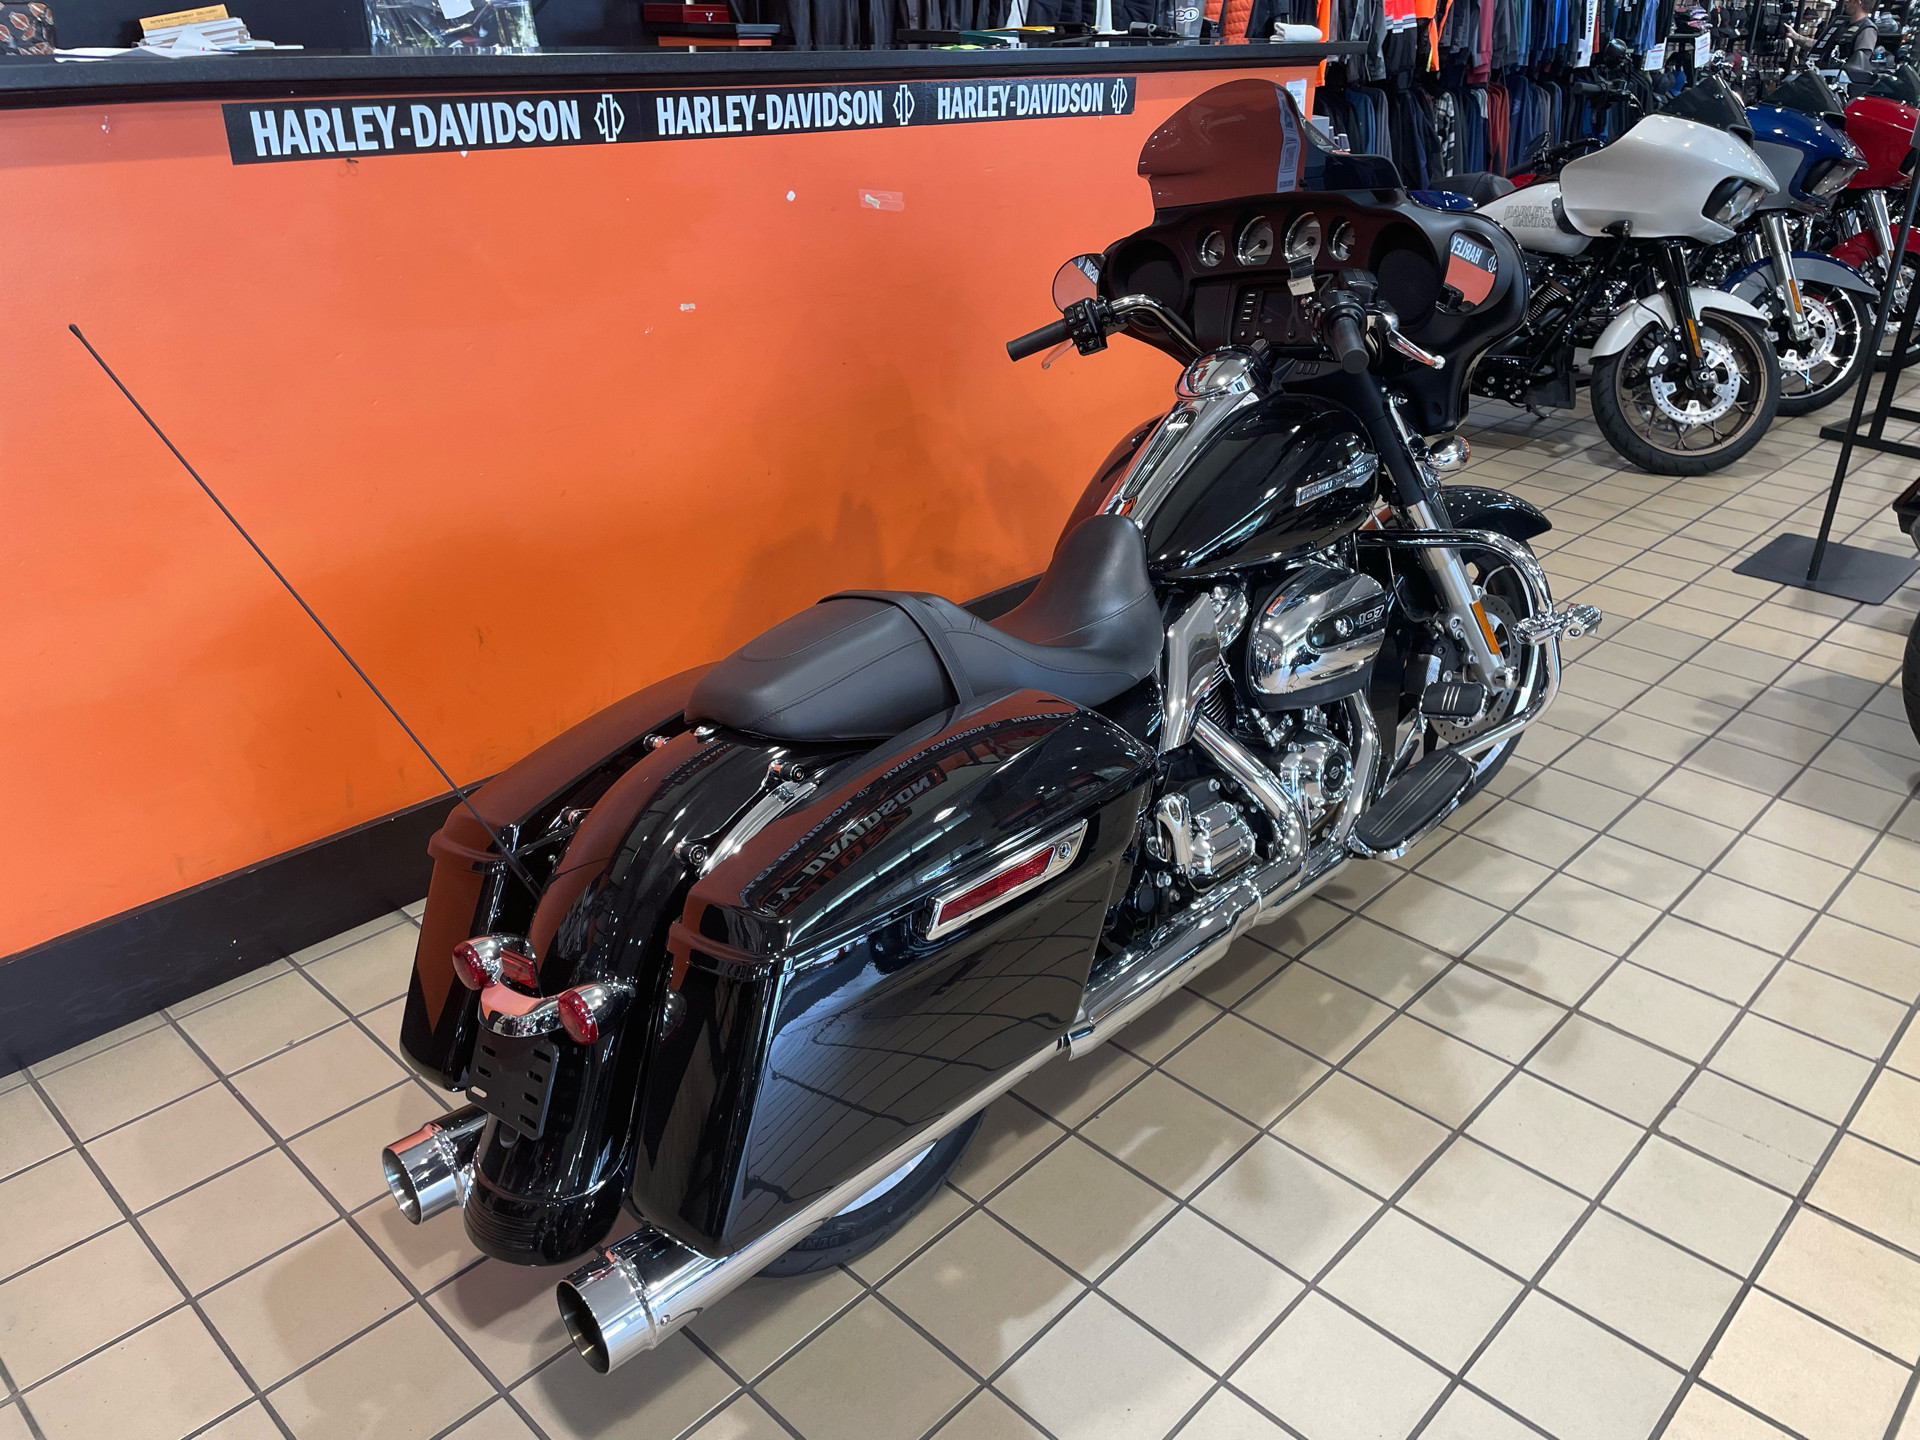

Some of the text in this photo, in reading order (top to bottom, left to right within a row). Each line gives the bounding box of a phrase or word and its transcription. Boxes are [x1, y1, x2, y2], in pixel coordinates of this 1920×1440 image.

[656, 90, 883, 136] HARLEY-DAVIDSON
[937, 82, 1104, 120] HARLEY-DAVIDSON
[249, 100, 581, 156] HARLEY-DAVIDSON
[1513, 216, 1558, 229] DAVIDSO
[1359, 604, 1385, 625] 107
